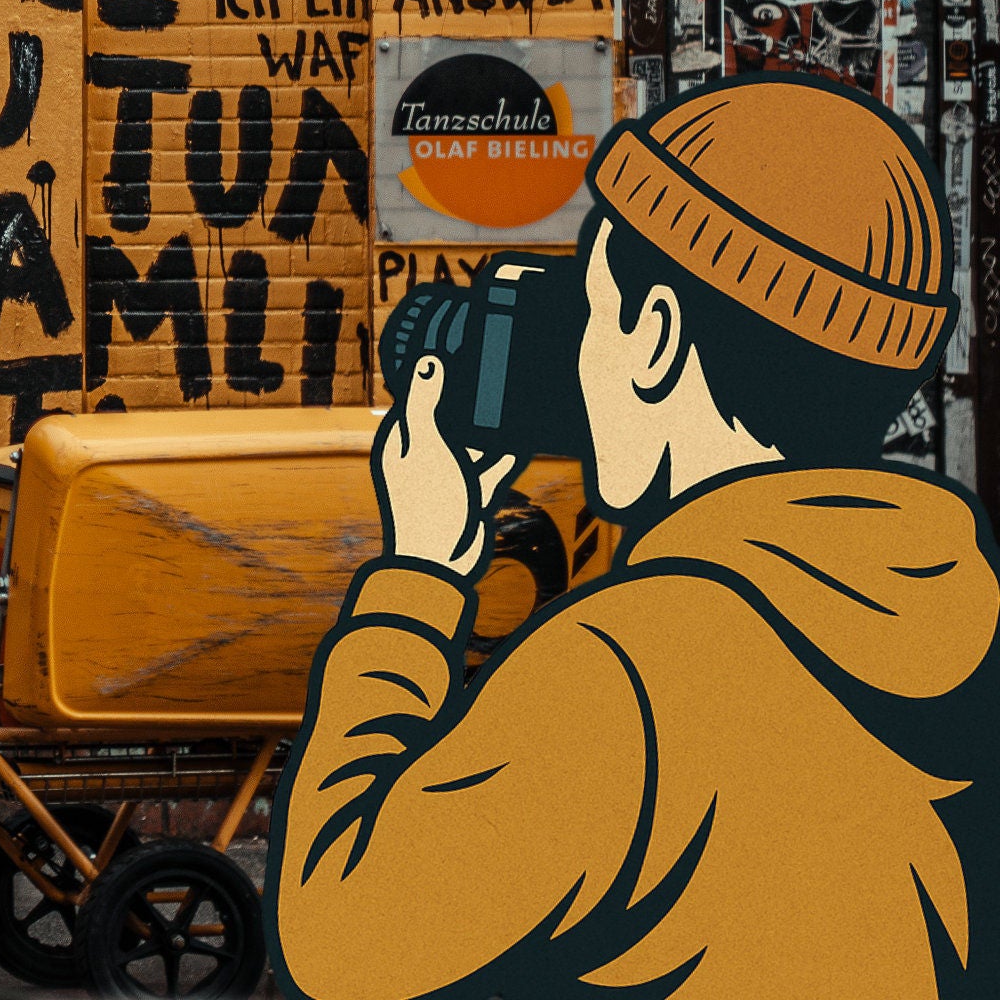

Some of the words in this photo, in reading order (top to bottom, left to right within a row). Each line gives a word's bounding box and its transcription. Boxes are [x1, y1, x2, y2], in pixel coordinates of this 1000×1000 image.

[401, 98, 551, 132] Tanzschule
[415, 139, 480, 159] OLAF
[487, 139, 590, 159] BIELING
